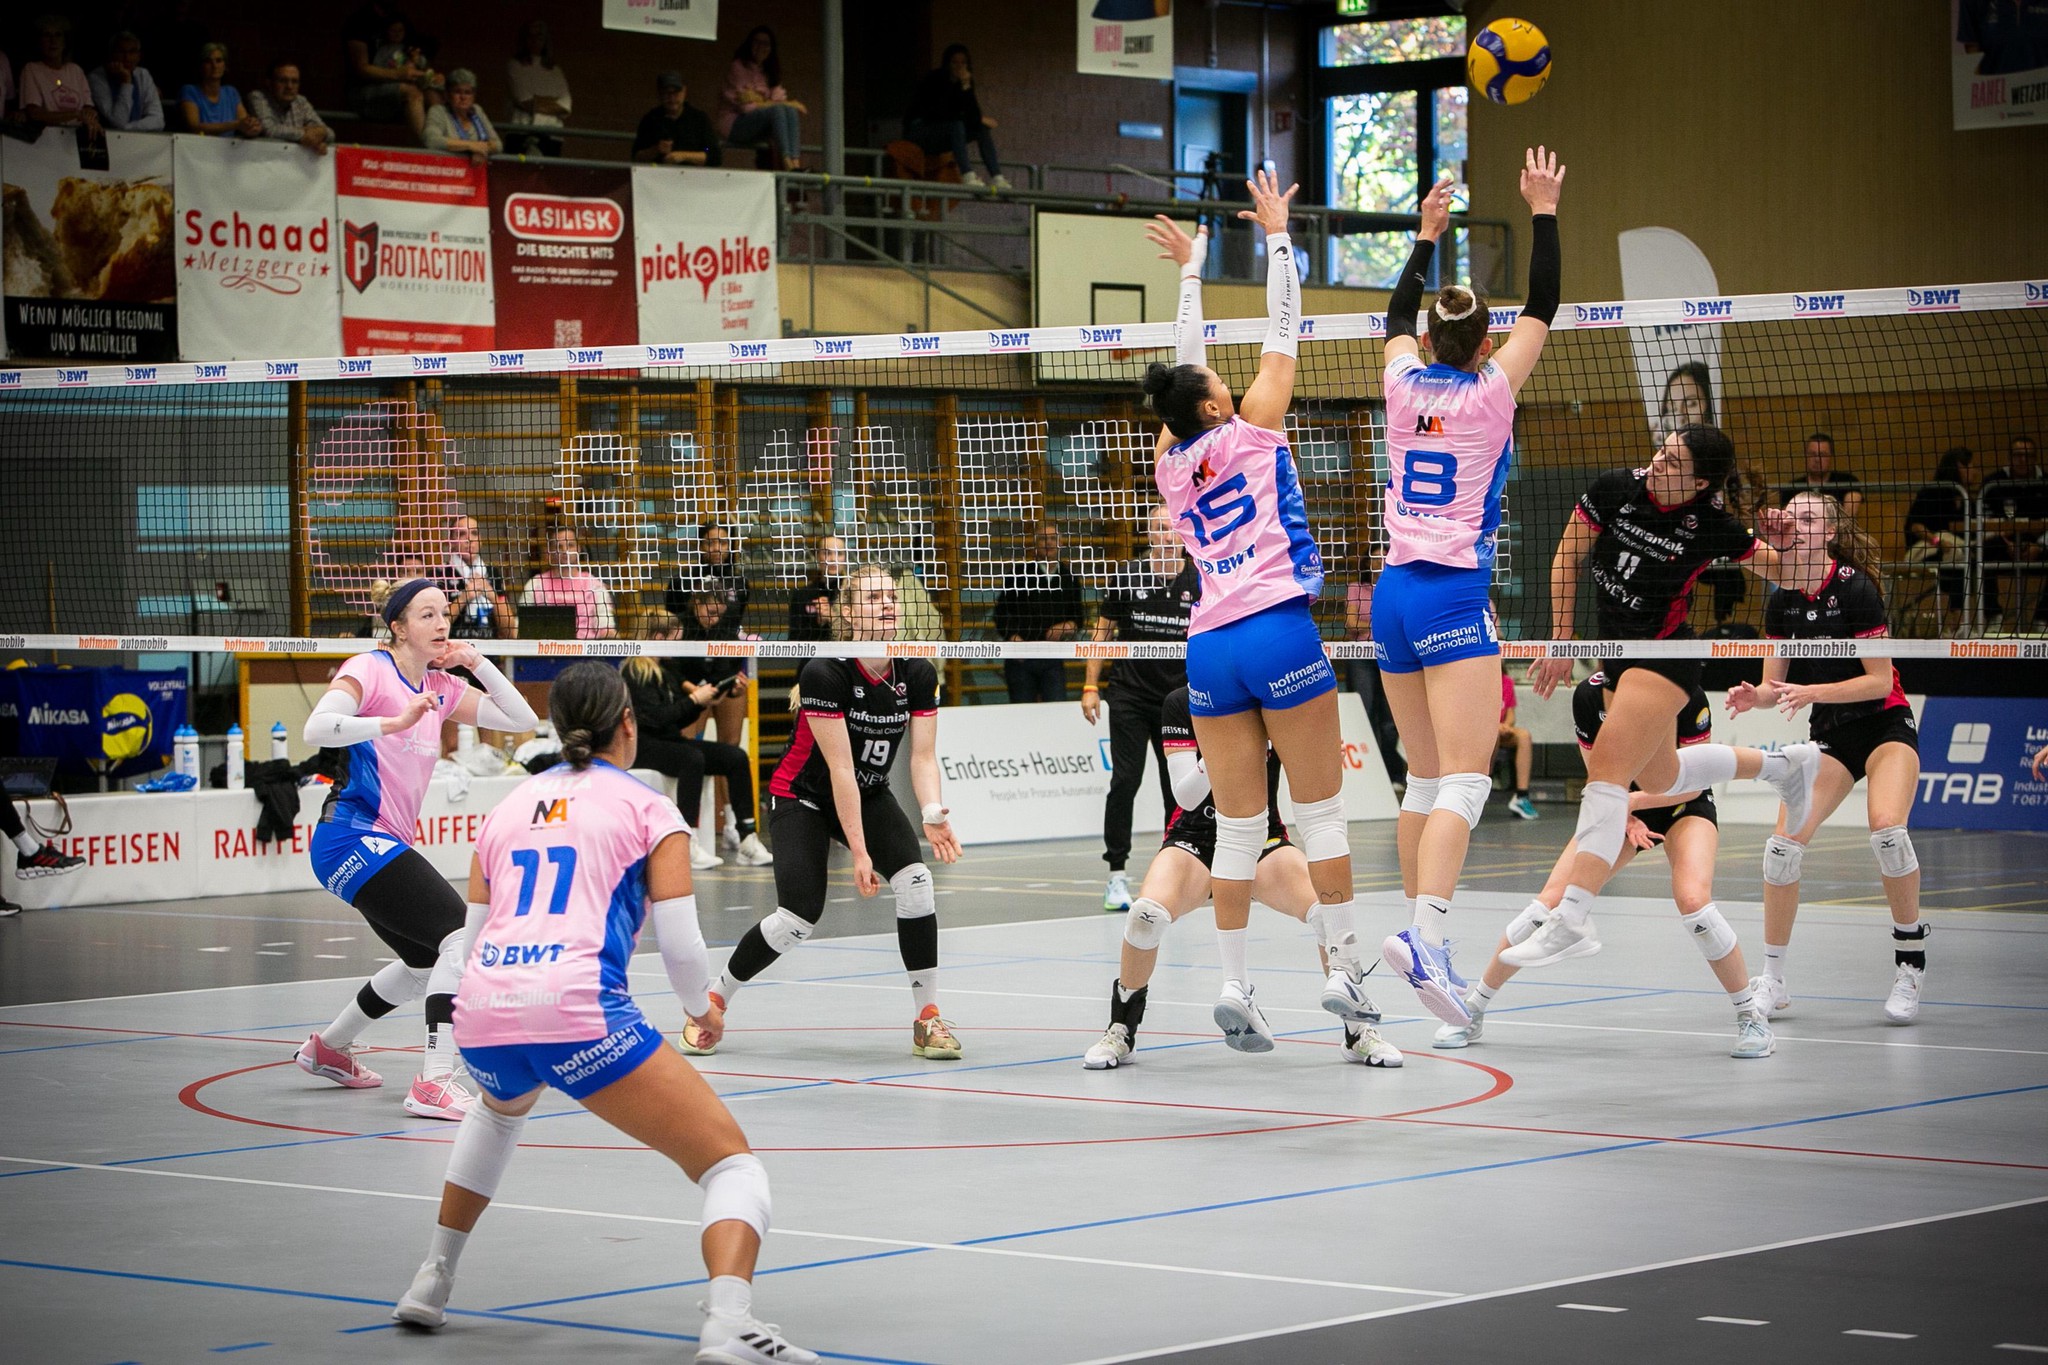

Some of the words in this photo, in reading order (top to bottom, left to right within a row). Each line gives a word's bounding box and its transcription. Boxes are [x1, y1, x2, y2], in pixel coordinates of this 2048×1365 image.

[514, 204, 614, 231] BASILISK
[185, 209, 328, 254] Schaad
[516, 243, 538, 256] DIE
[538, 244, 589, 259] BESCHTE
[589, 246, 615, 259] HITS
[197, 250, 318, 280] Metzgerei
[642, 241, 692, 294] pick
[721, 236, 770, 276] bike
[1809, 295, 1845, 311] BWT
[1923, 289, 1961, 304] BWT
[1590, 305, 1624, 321] BWT
[1697, 300, 1733, 315] BWT
[61, 304, 112, 329] MÖGLICH
[115, 309, 165, 332] REGIONAL
[50, 333, 77, 353] UND
[80, 331, 138, 355] NATÜRLICH
[912, 336, 940, 350] BWT
[1001, 333, 1030, 347] BWT
[1093, 328, 1123, 343] BWT
[658, 347, 684, 360] BWT
[741, 343, 768, 357] BWT
[825, 340, 853, 354] BWT
[422, 357, 447, 369] BWT
[499, 353, 524, 366] BWT
[578, 350, 603, 363] BWT
[135, 368, 157, 380] BWT
[204, 365, 227, 377] BWT
[276, 363, 298, 375] BWT
[349, 360, 372, 372] BWT
[67, 370, 89, 382] BWT
[1402, 450, 1458, 506] 8
[1180, 472, 1257, 549] 15
[1217, 544, 1257, 575] BWT
[79, 636, 118, 649] hoffmann
[120, 637, 168, 650] automobile
[224, 638, 266, 651] hoffmann
[268, 638, 318, 652] automobile
[1413, 622, 1477, 652] hoffmann
[538, 641, 583, 655] hoffmann
[587, 641, 642, 655] automobile
[707, 642, 755, 656] hoffmann
[759, 642, 816, 657] automobile
[886, 642, 936, 657] hoffmann
[940, 642, 1001, 658] automobile
[1075, 642, 1129, 658] hoffmann
[1133, 643, 1187, 658] automobi
[1336, 643, 1375, 658] autom
[1419, 634, 1479, 657] automobile
[1552, 642, 1623, 658] automobile
[1711, 641, 1775, 657] hoffmann
[1780, 641, 1856, 657] automobile
[1950, 641, 2018, 657] hoffmann
[1268, 659, 1325, 693] hoffmann
[1272, 668, 1329, 699] automobile
[861, 739, 891, 767] 19
[941, 750, 1095, 781] Endress+Hauser
[990, 789, 1017, 801] People
[502, 944, 565, 966] BWT
[488, 989, 564, 1009] Mobiliar
[564, 1034, 639, 1086] automobile
